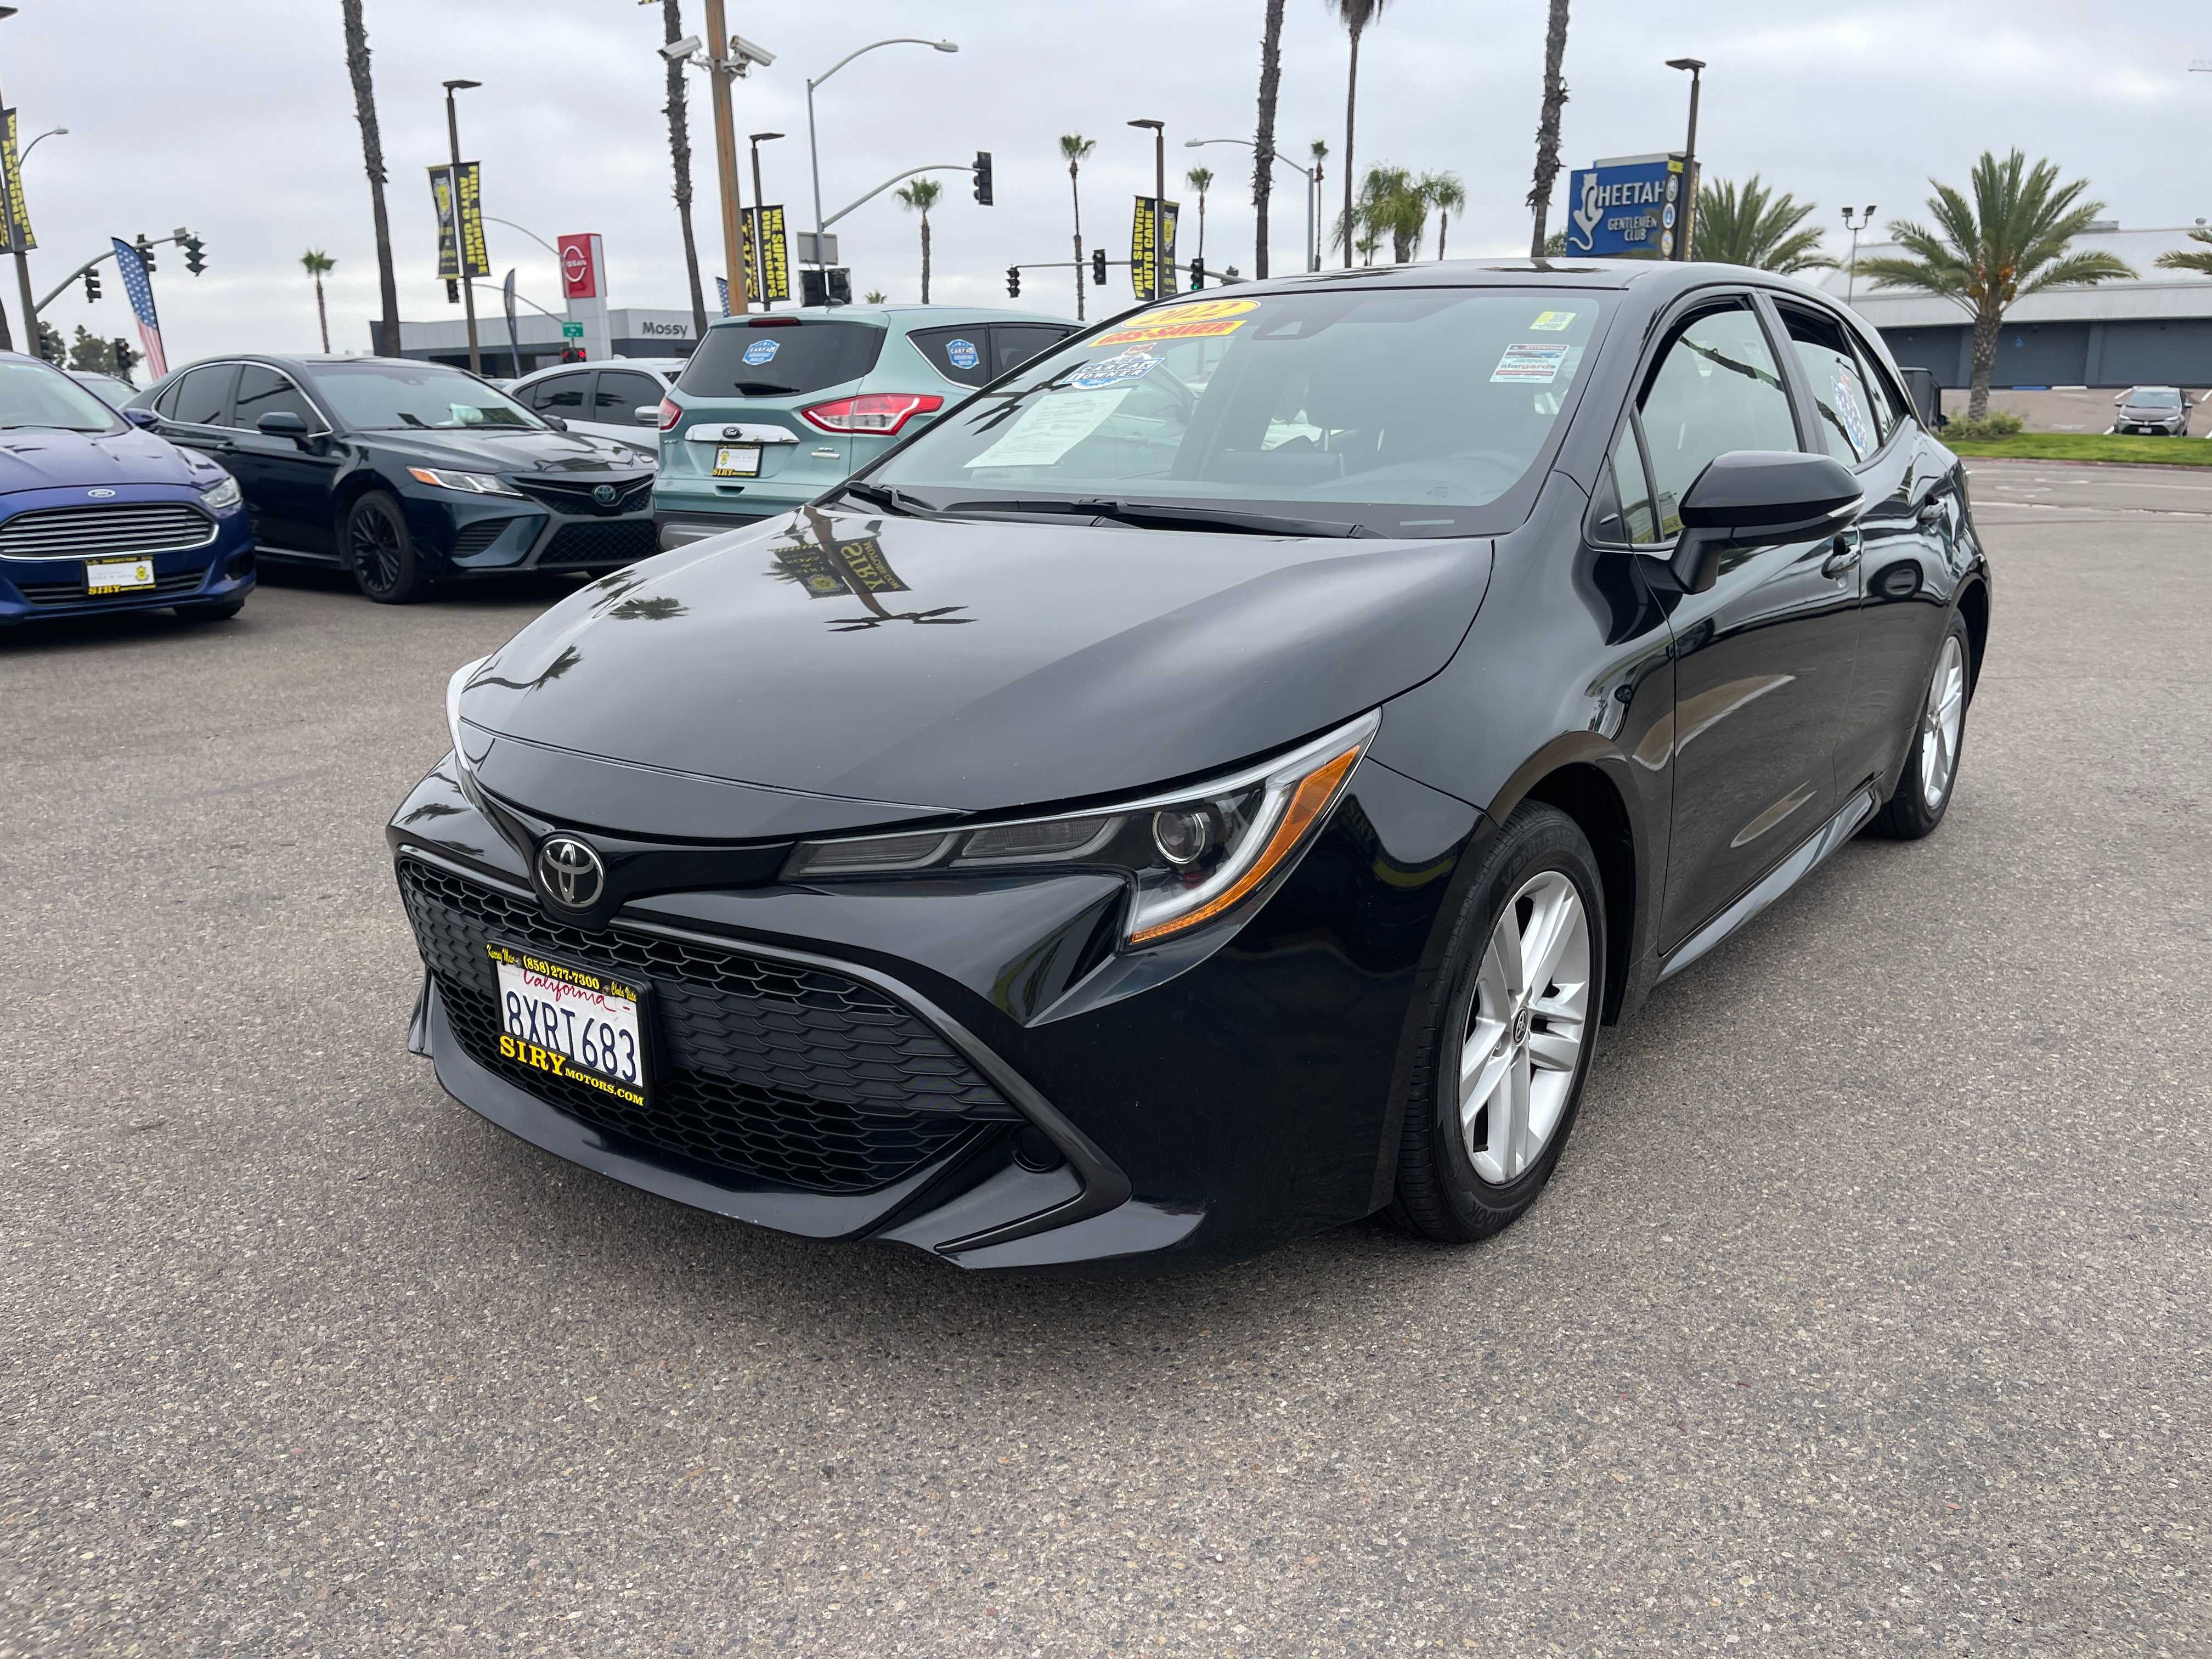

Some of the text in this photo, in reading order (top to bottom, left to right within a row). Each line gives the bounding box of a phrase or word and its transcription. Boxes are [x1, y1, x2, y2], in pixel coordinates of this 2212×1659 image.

[459, 176, 477, 264] AUTO CARE
[468, 166, 488, 274] FULL SERVICE
[761, 210, 777, 298] OUR TROOPS
[771, 208, 788, 297] WE SUPPORT
[1132, 199, 1146, 297] FULL SERVICE
[1143, 211, 1154, 290] AUTO CARE
[1624, 228, 1646, 241] CLUB
[642, 321, 688, 338] Mossy
[1081, 361, 1152, 373] CARFAX
[88, 585, 121, 595] SIRY
[523, 955, 550, 975] (858)
[551, 966, 600, 990] 277-7300
[523, 970, 617, 1012] California
[500, 1035, 644, 1107] SIRY MOTORS.COM
[506, 991, 636, 1083] 8XRT683
